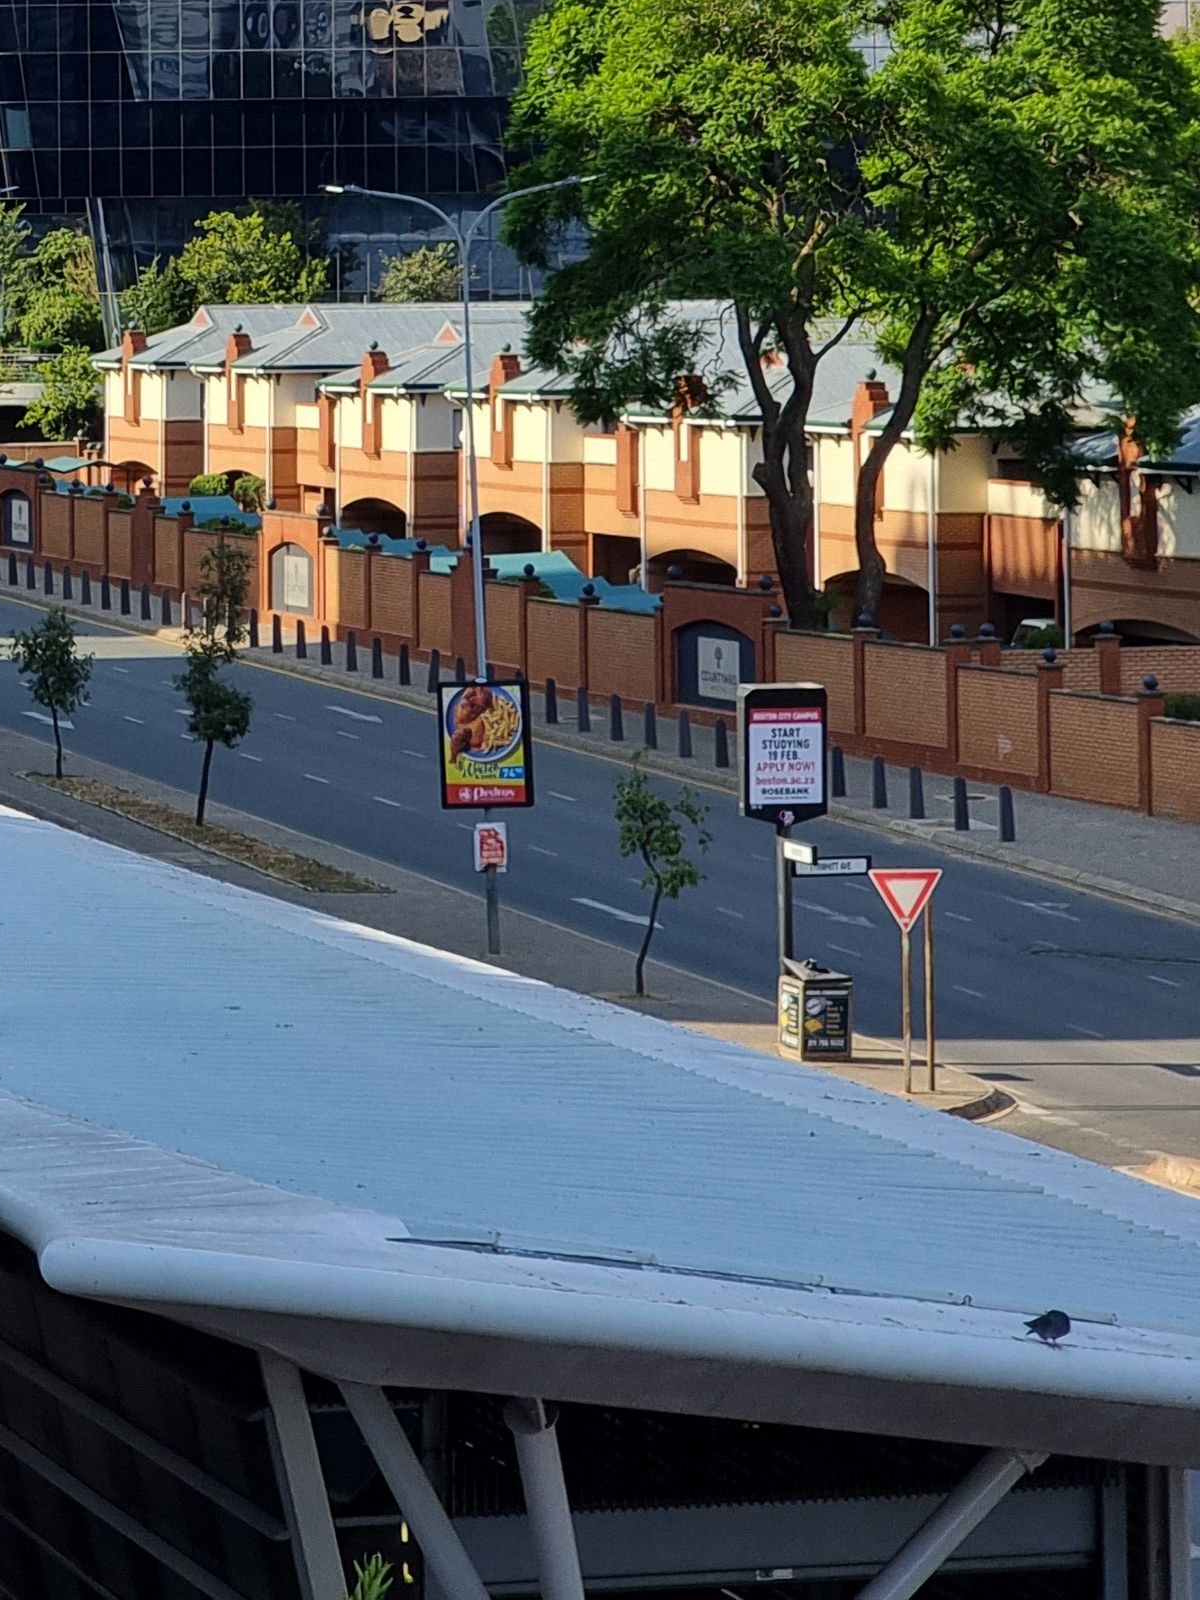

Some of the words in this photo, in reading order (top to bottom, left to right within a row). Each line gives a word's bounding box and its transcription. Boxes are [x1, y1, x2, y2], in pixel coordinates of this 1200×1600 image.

[771, 728, 801, 738] START
[761, 740, 811, 750] STUDYING
[757, 761, 785, 772] APPLY
[787, 761, 816, 771] NOW!
[755, 776, 816, 786] boston.ac.za
[761, 787, 811, 796] ROSEBANK
